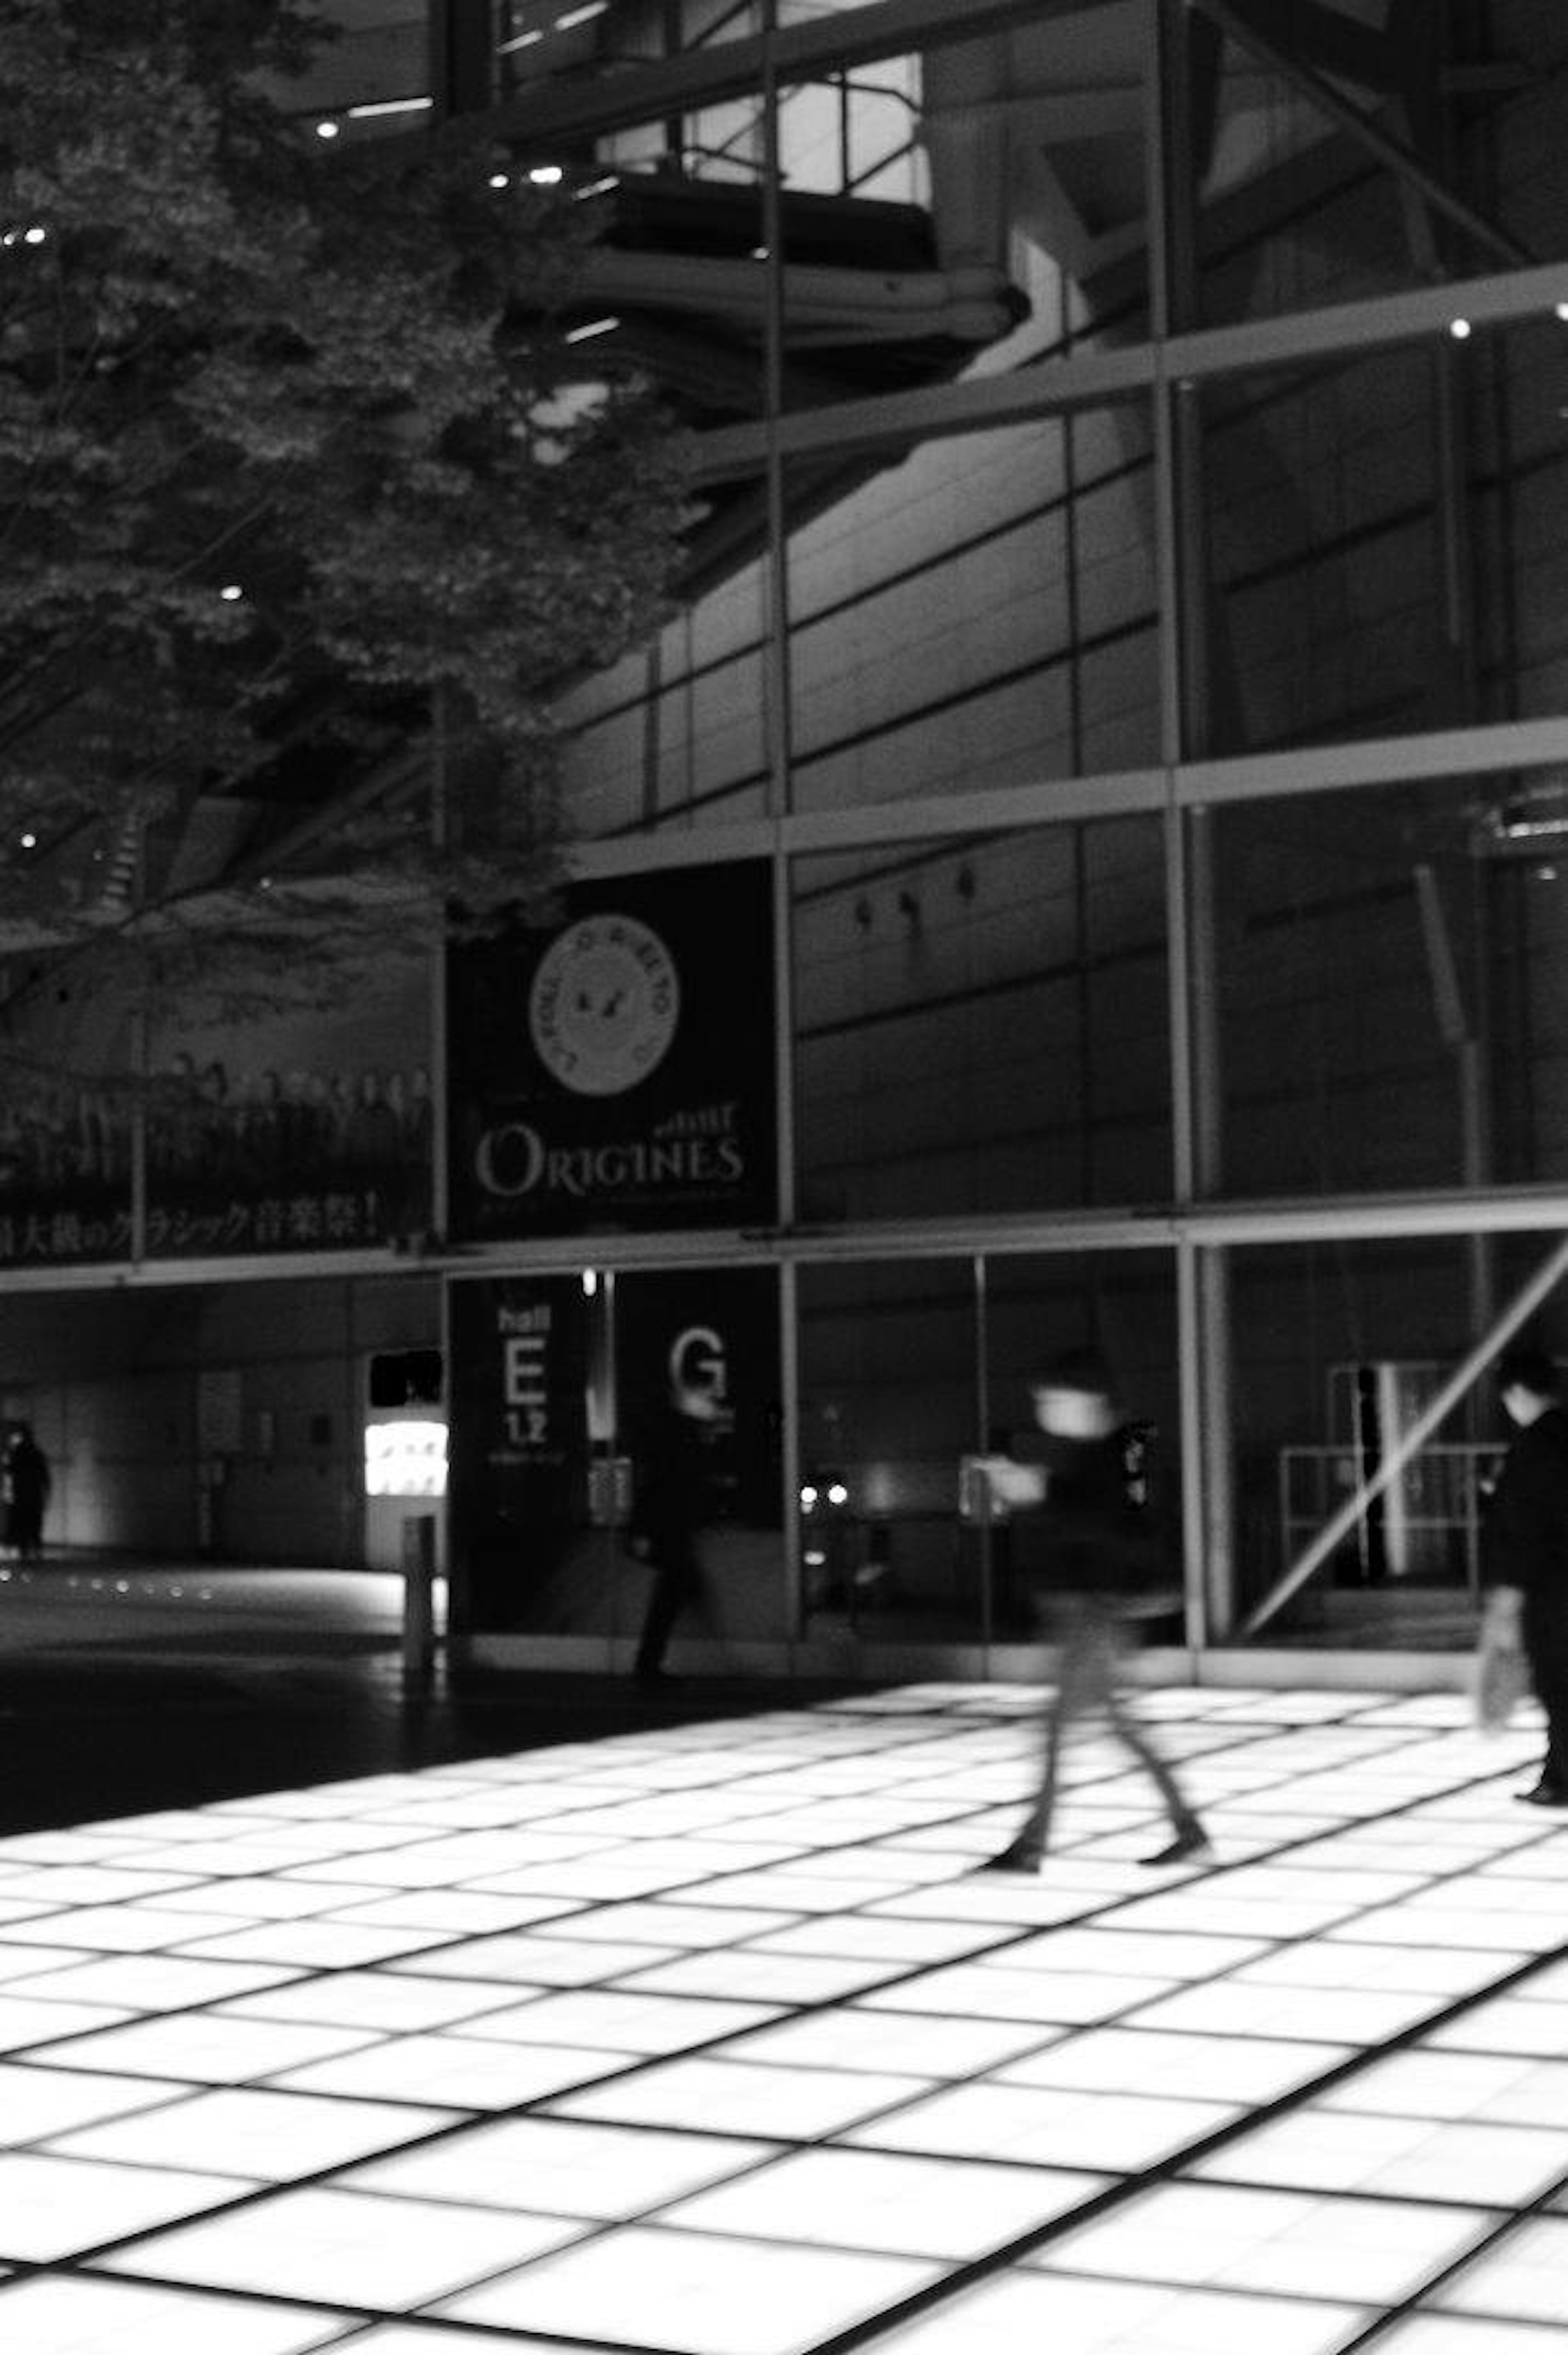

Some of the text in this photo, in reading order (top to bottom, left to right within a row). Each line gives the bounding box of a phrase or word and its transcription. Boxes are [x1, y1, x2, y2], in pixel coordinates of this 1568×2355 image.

[498, 1304, 551, 1332] hall
[506, 1336, 547, 1406] E
[669, 1326, 727, 1401] G
